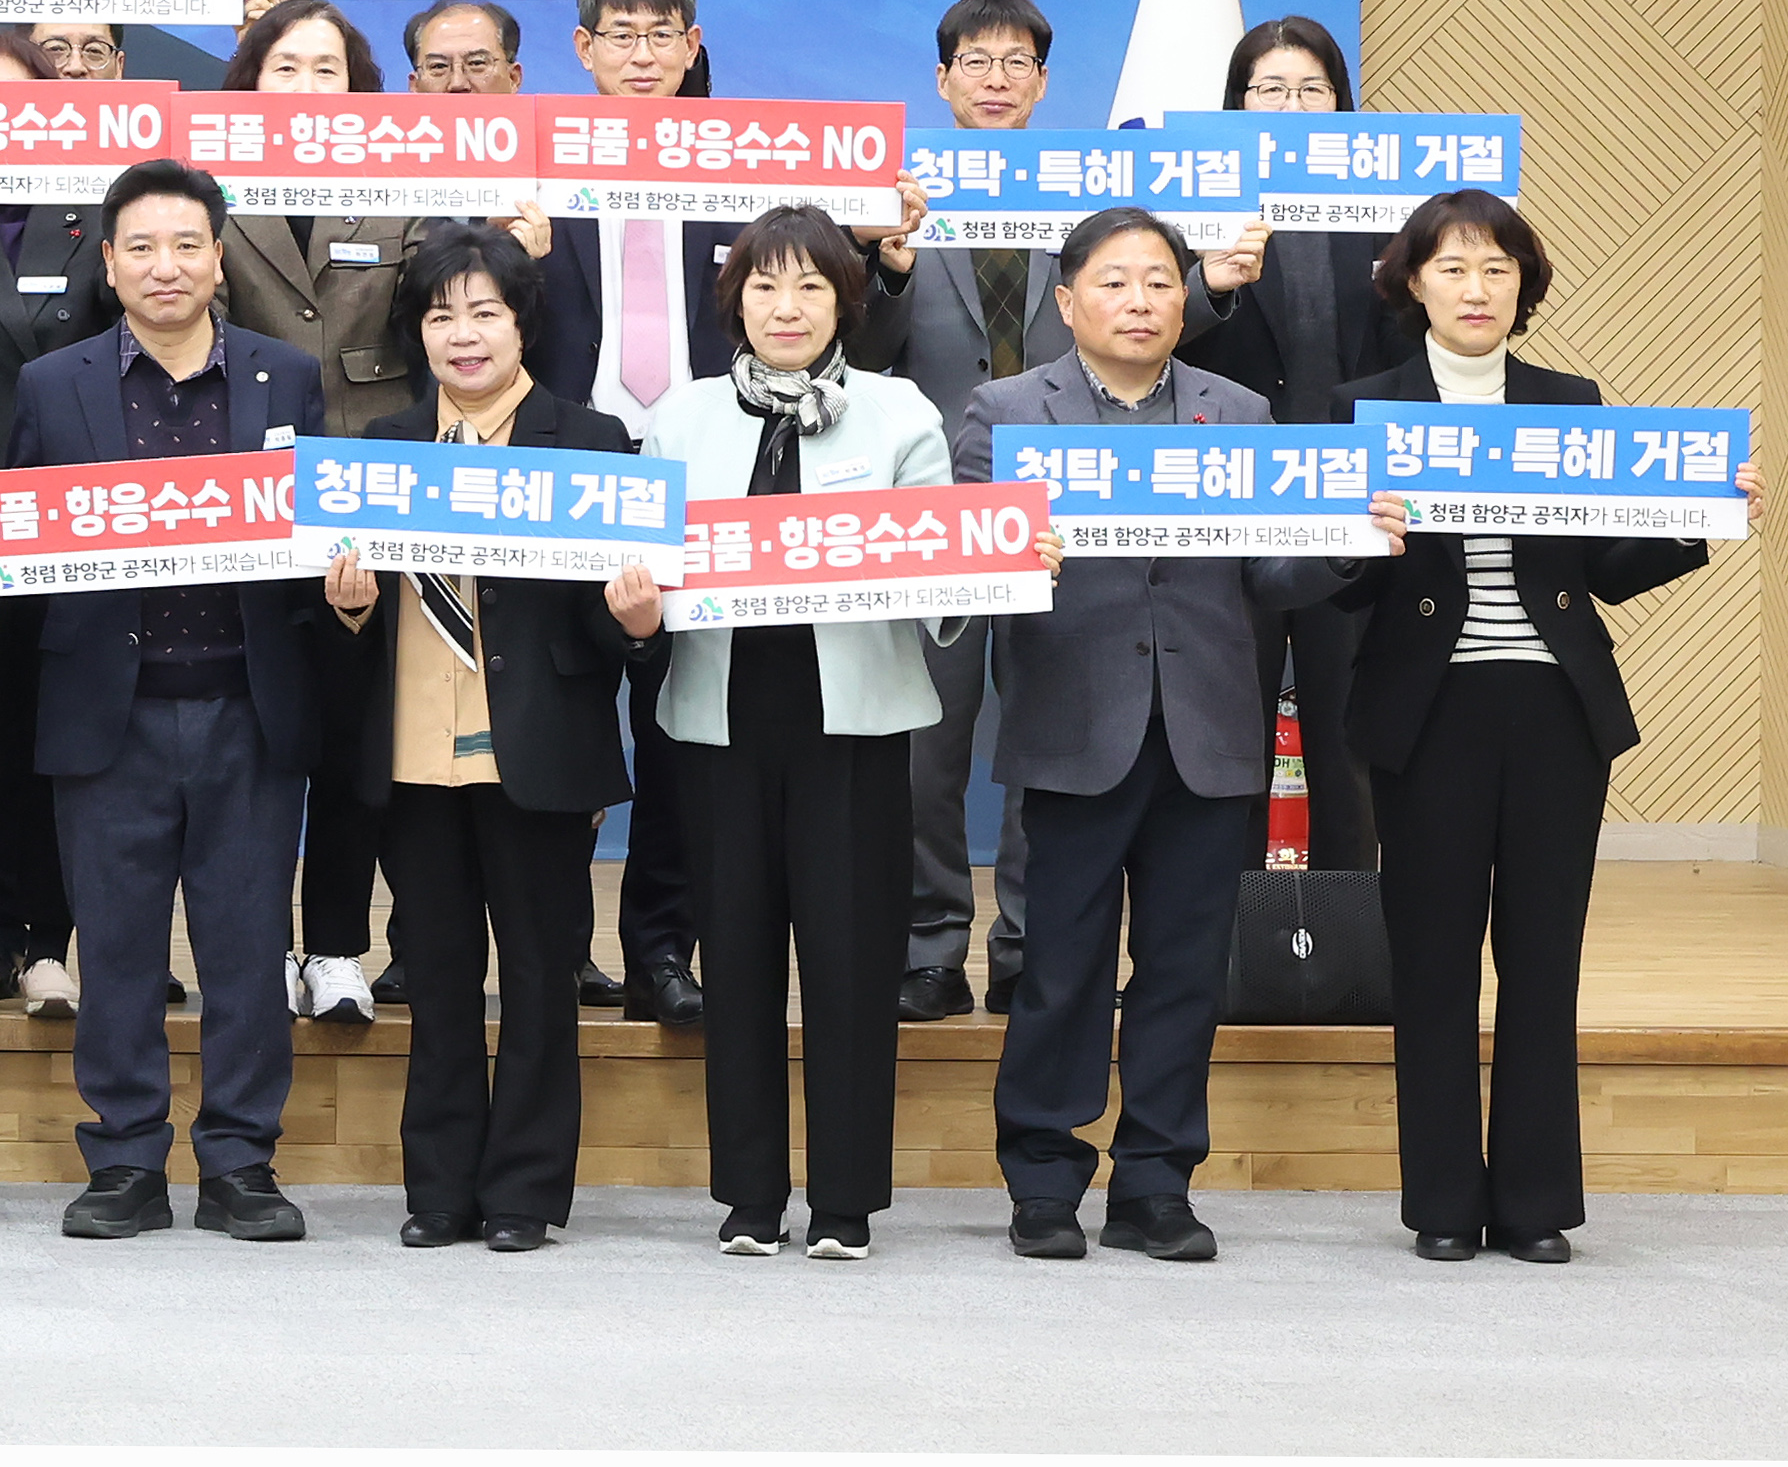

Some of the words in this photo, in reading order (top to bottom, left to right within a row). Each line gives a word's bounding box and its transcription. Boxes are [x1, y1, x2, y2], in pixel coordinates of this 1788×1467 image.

[99, 103, 162, 149] NO
[455, 116, 519, 162] NO
[822, 125, 887, 172] NO
[1150, 150, 1241, 198] 거절
[1415, 135, 1504, 183] 거절
[243, 187, 276, 206] 청렴
[281, 187, 334, 206] 함양군
[338, 187, 407, 206] 공직자가
[1271, 447, 1369, 500] 거절
[1631, 430, 1730, 483] 거절
[569, 473, 668, 529] 거절
[1429, 502, 1466, 523] 청렴
[1471, 503, 1528, 525] 함양군
[1532, 505, 1607, 527] 공직자가
[960, 505, 1031, 558] NO
[1072, 526, 1108, 546] 청렴
[1114, 526, 1170, 547] 함양군
[1174, 526, 1249, 547] 공직자가
[19, 564, 56, 585] 청렴
[61, 560, 117, 582] 함양군
[121, 555, 195, 579] 공직자가
[730, 596, 767, 618] 청렴
[772, 593, 830, 615] 함양군
[834, 588, 910, 612] 공직자가
